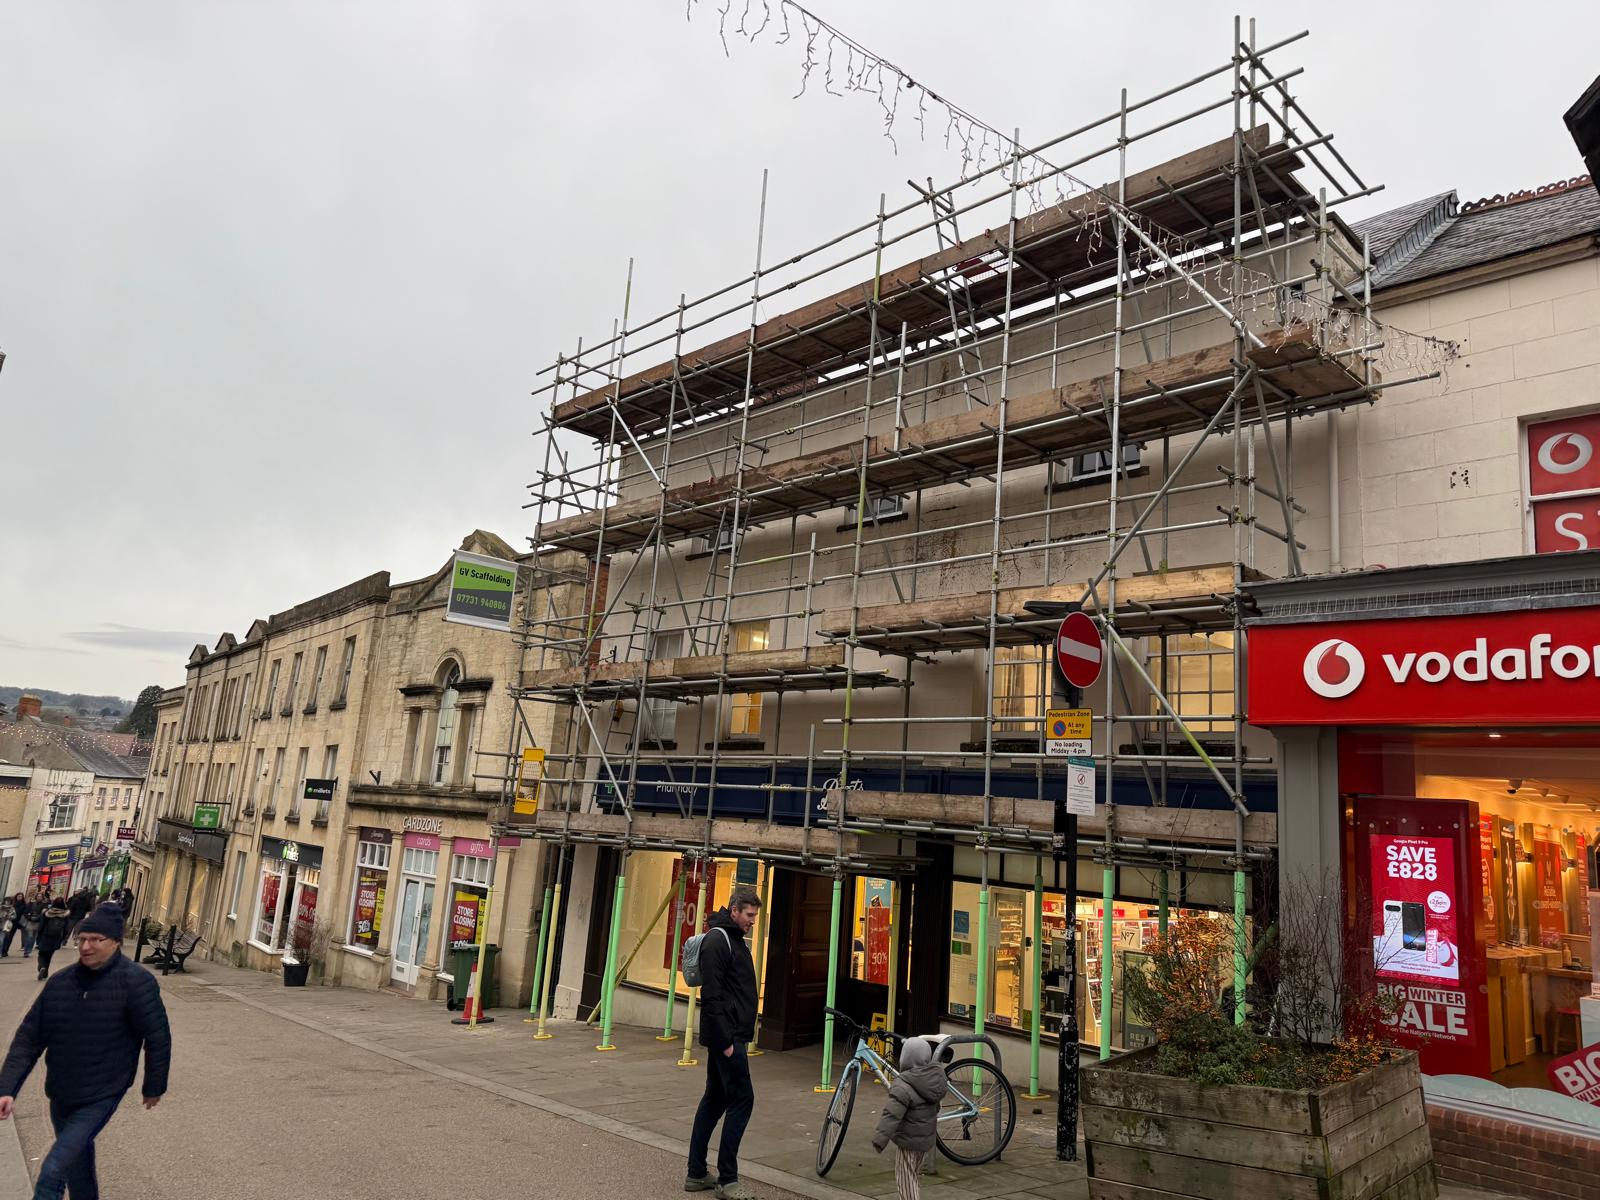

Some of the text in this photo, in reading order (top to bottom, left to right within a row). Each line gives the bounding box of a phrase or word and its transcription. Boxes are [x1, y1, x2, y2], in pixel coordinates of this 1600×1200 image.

[1554, 510, 1600, 550] S
[459, 568, 511, 587] GV Scaffolding
[1382, 634, 1600, 684] vodafo
[402, 816, 442, 832] CARDZONE
[416, 836, 432, 847] cards
[470, 840, 485, 854] gifts
[1386, 845, 1437, 864] SAVE
[1387, 862, 1438, 882] £828
[360, 889, 376, 900] STORE
[456, 905, 474, 918] STORE
[453, 915, 476, 928] CLOSING
[1377, 982, 1465, 1005] BIG WINTER
